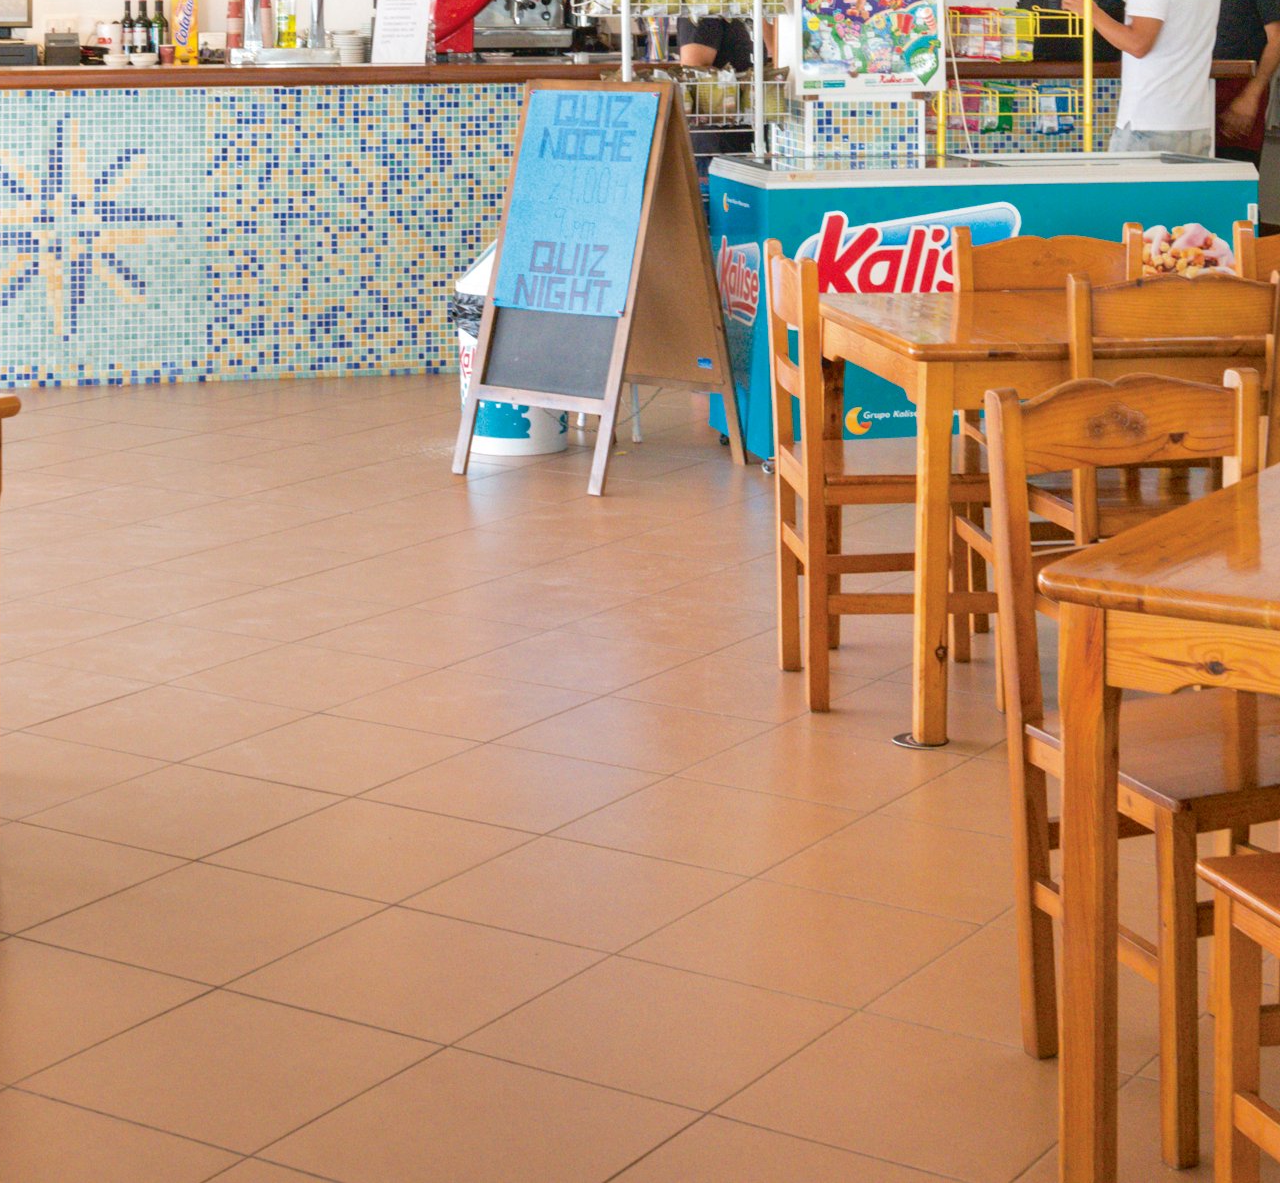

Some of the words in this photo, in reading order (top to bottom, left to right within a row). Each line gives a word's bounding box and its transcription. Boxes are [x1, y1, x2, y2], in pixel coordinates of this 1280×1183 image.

[554, 94, 634, 128] QUIZ
[538, 126, 637, 162] NOCHE
[529, 240, 609, 278] QUIZ
[513, 274, 612, 313] NIGHT
[719, 239, 759, 317] Kalise
[863, 411, 891, 420] Grupo
